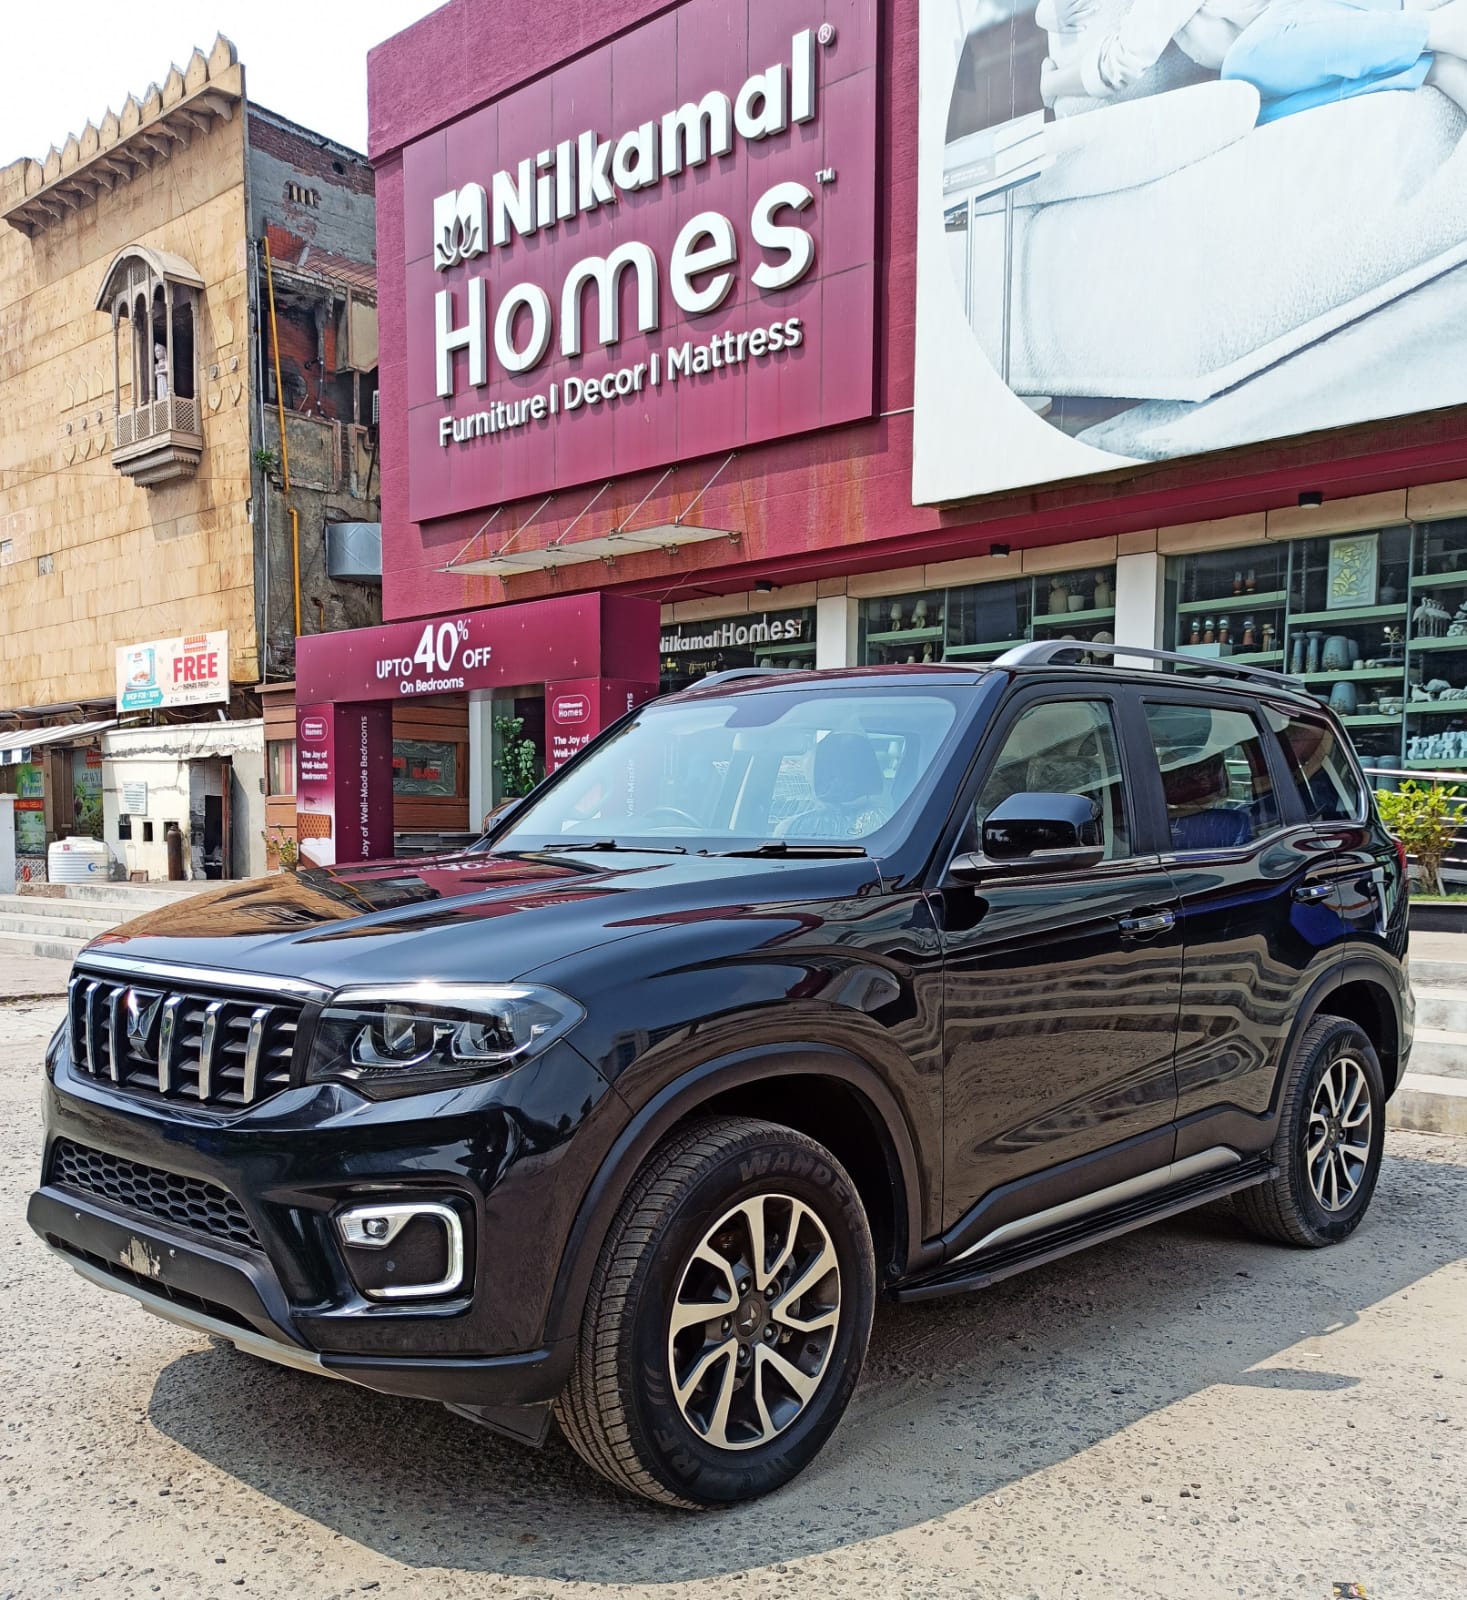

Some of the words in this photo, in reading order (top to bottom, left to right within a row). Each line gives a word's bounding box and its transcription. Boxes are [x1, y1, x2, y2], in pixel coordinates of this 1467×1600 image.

[492, 28, 816, 247] Nilkamal
[435, 181, 814, 399] Homes
[439, 394, 546, 447] Furniture
[564, 364, 645, 410] Decor
[667, 317, 803, 381] Mattress
[721, 619, 795, 647] Homes
[173, 652, 218, 683] FREE
[376, 657, 413, 679] UPTO
[462, 646, 492, 669] OFF
[400, 681, 414, 694] On
[416, 677, 464, 692] Bedrooms
[558, 709, 583, 718] Homes
[360, 716, 369, 767] Bedrooms
[553, 735, 567, 745] The
[568, 735, 580, 746] Joy
[553, 749, 578, 759] Well-M
[360, 769, 369, 823] Well-Made
[360, 826, 369, 837] of
[360, 839, 371, 857] Joy
